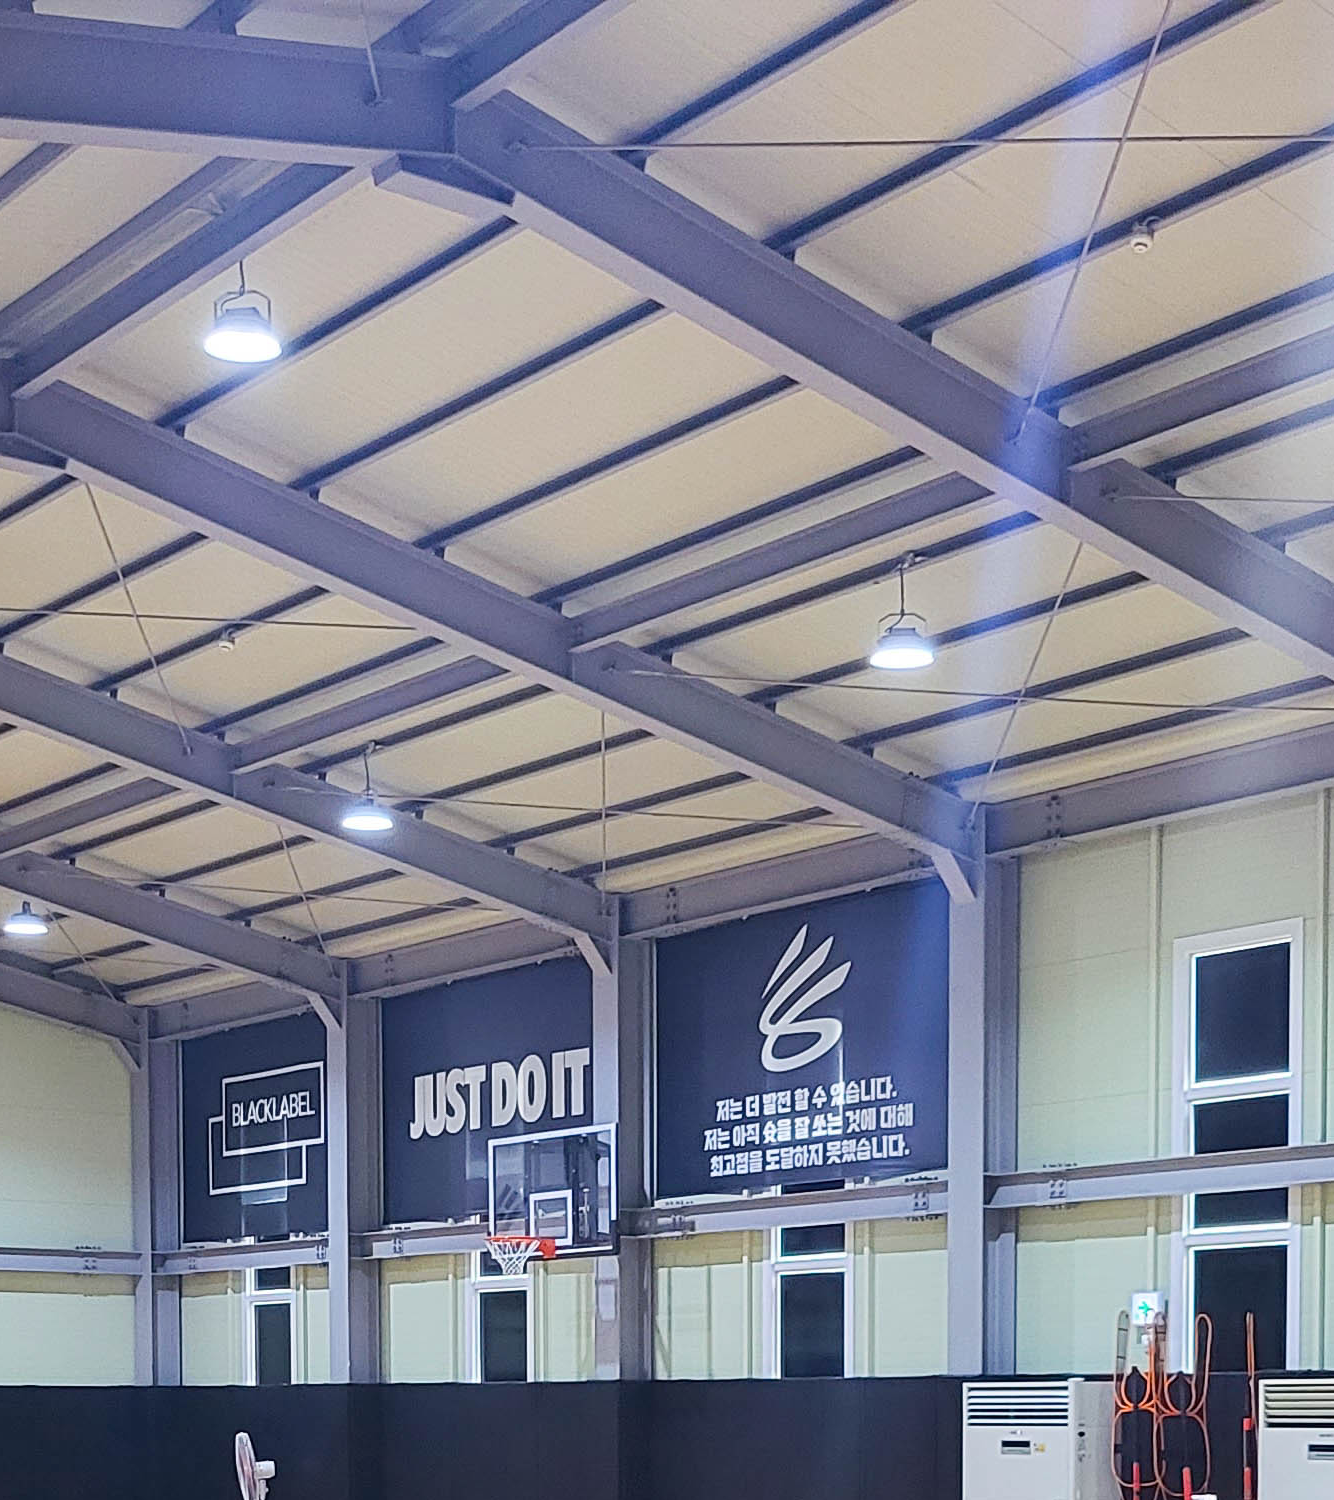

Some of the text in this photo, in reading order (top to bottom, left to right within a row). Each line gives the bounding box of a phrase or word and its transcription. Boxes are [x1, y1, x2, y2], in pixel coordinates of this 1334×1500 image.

[231, 1091, 315, 1127] BLACKLABEL
[409, 1048, 590, 1140] JUST DO IT
[715, 1076, 897, 1122] 저는 더 발전 할 수 있습니다.
[704, 1103, 914, 1151] 저는 아직 슛을 잘 쏘는 것에 대해
[709, 1134, 910, 1177] 최고점을 도달하지 못했습니다.
